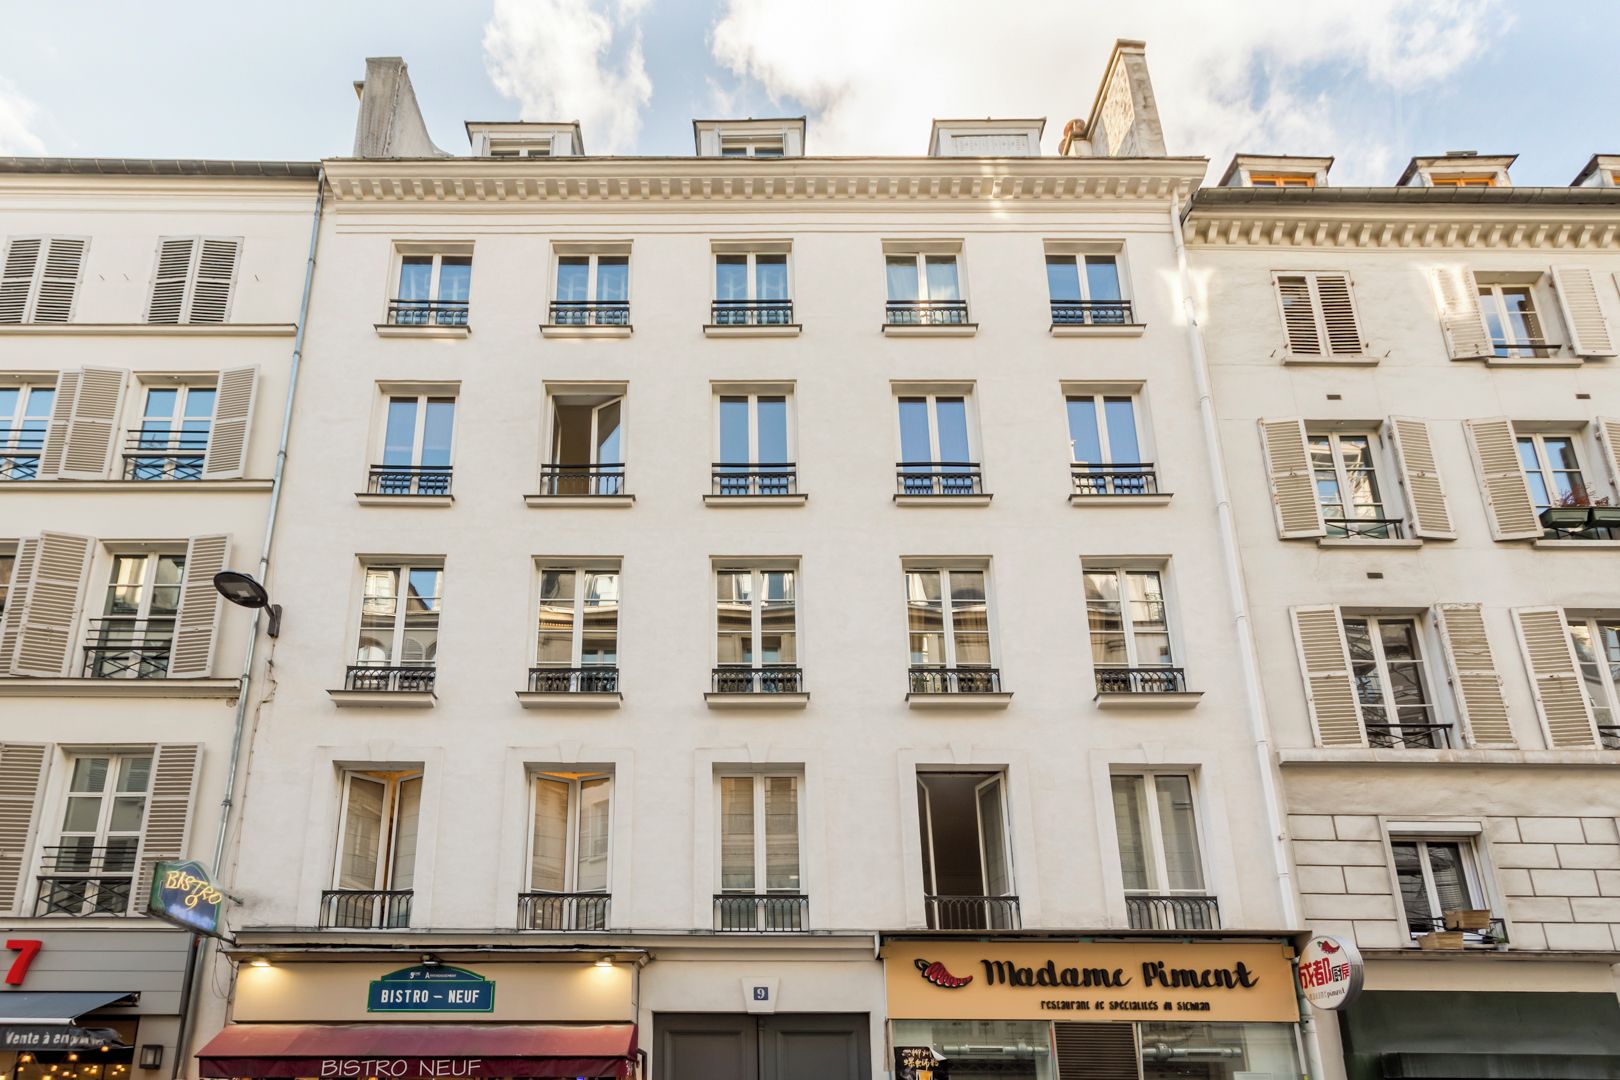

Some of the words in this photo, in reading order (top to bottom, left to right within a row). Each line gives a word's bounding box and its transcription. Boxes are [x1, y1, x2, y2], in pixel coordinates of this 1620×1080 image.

[165, 870, 222, 905] BISTRO
[185, 894, 198, 910] 9
[5, 939, 43, 986] 7
[980, 959, 1133, 988] Madame
[1142, 960, 1260, 989] Piment
[380, 989, 429, 1003] BISTRO
[448, 989, 480, 1004] NEUF
[756, 988, 765, 1000] 9
[1040, 1000, 1090, 1010] restaurant
[6, 1032, 40, 1045] Vente
[42, 1032, 51, 1045] à
[321, 1059, 408, 1077] BISTRO
[419, 1059, 482, 1076] NEUF
